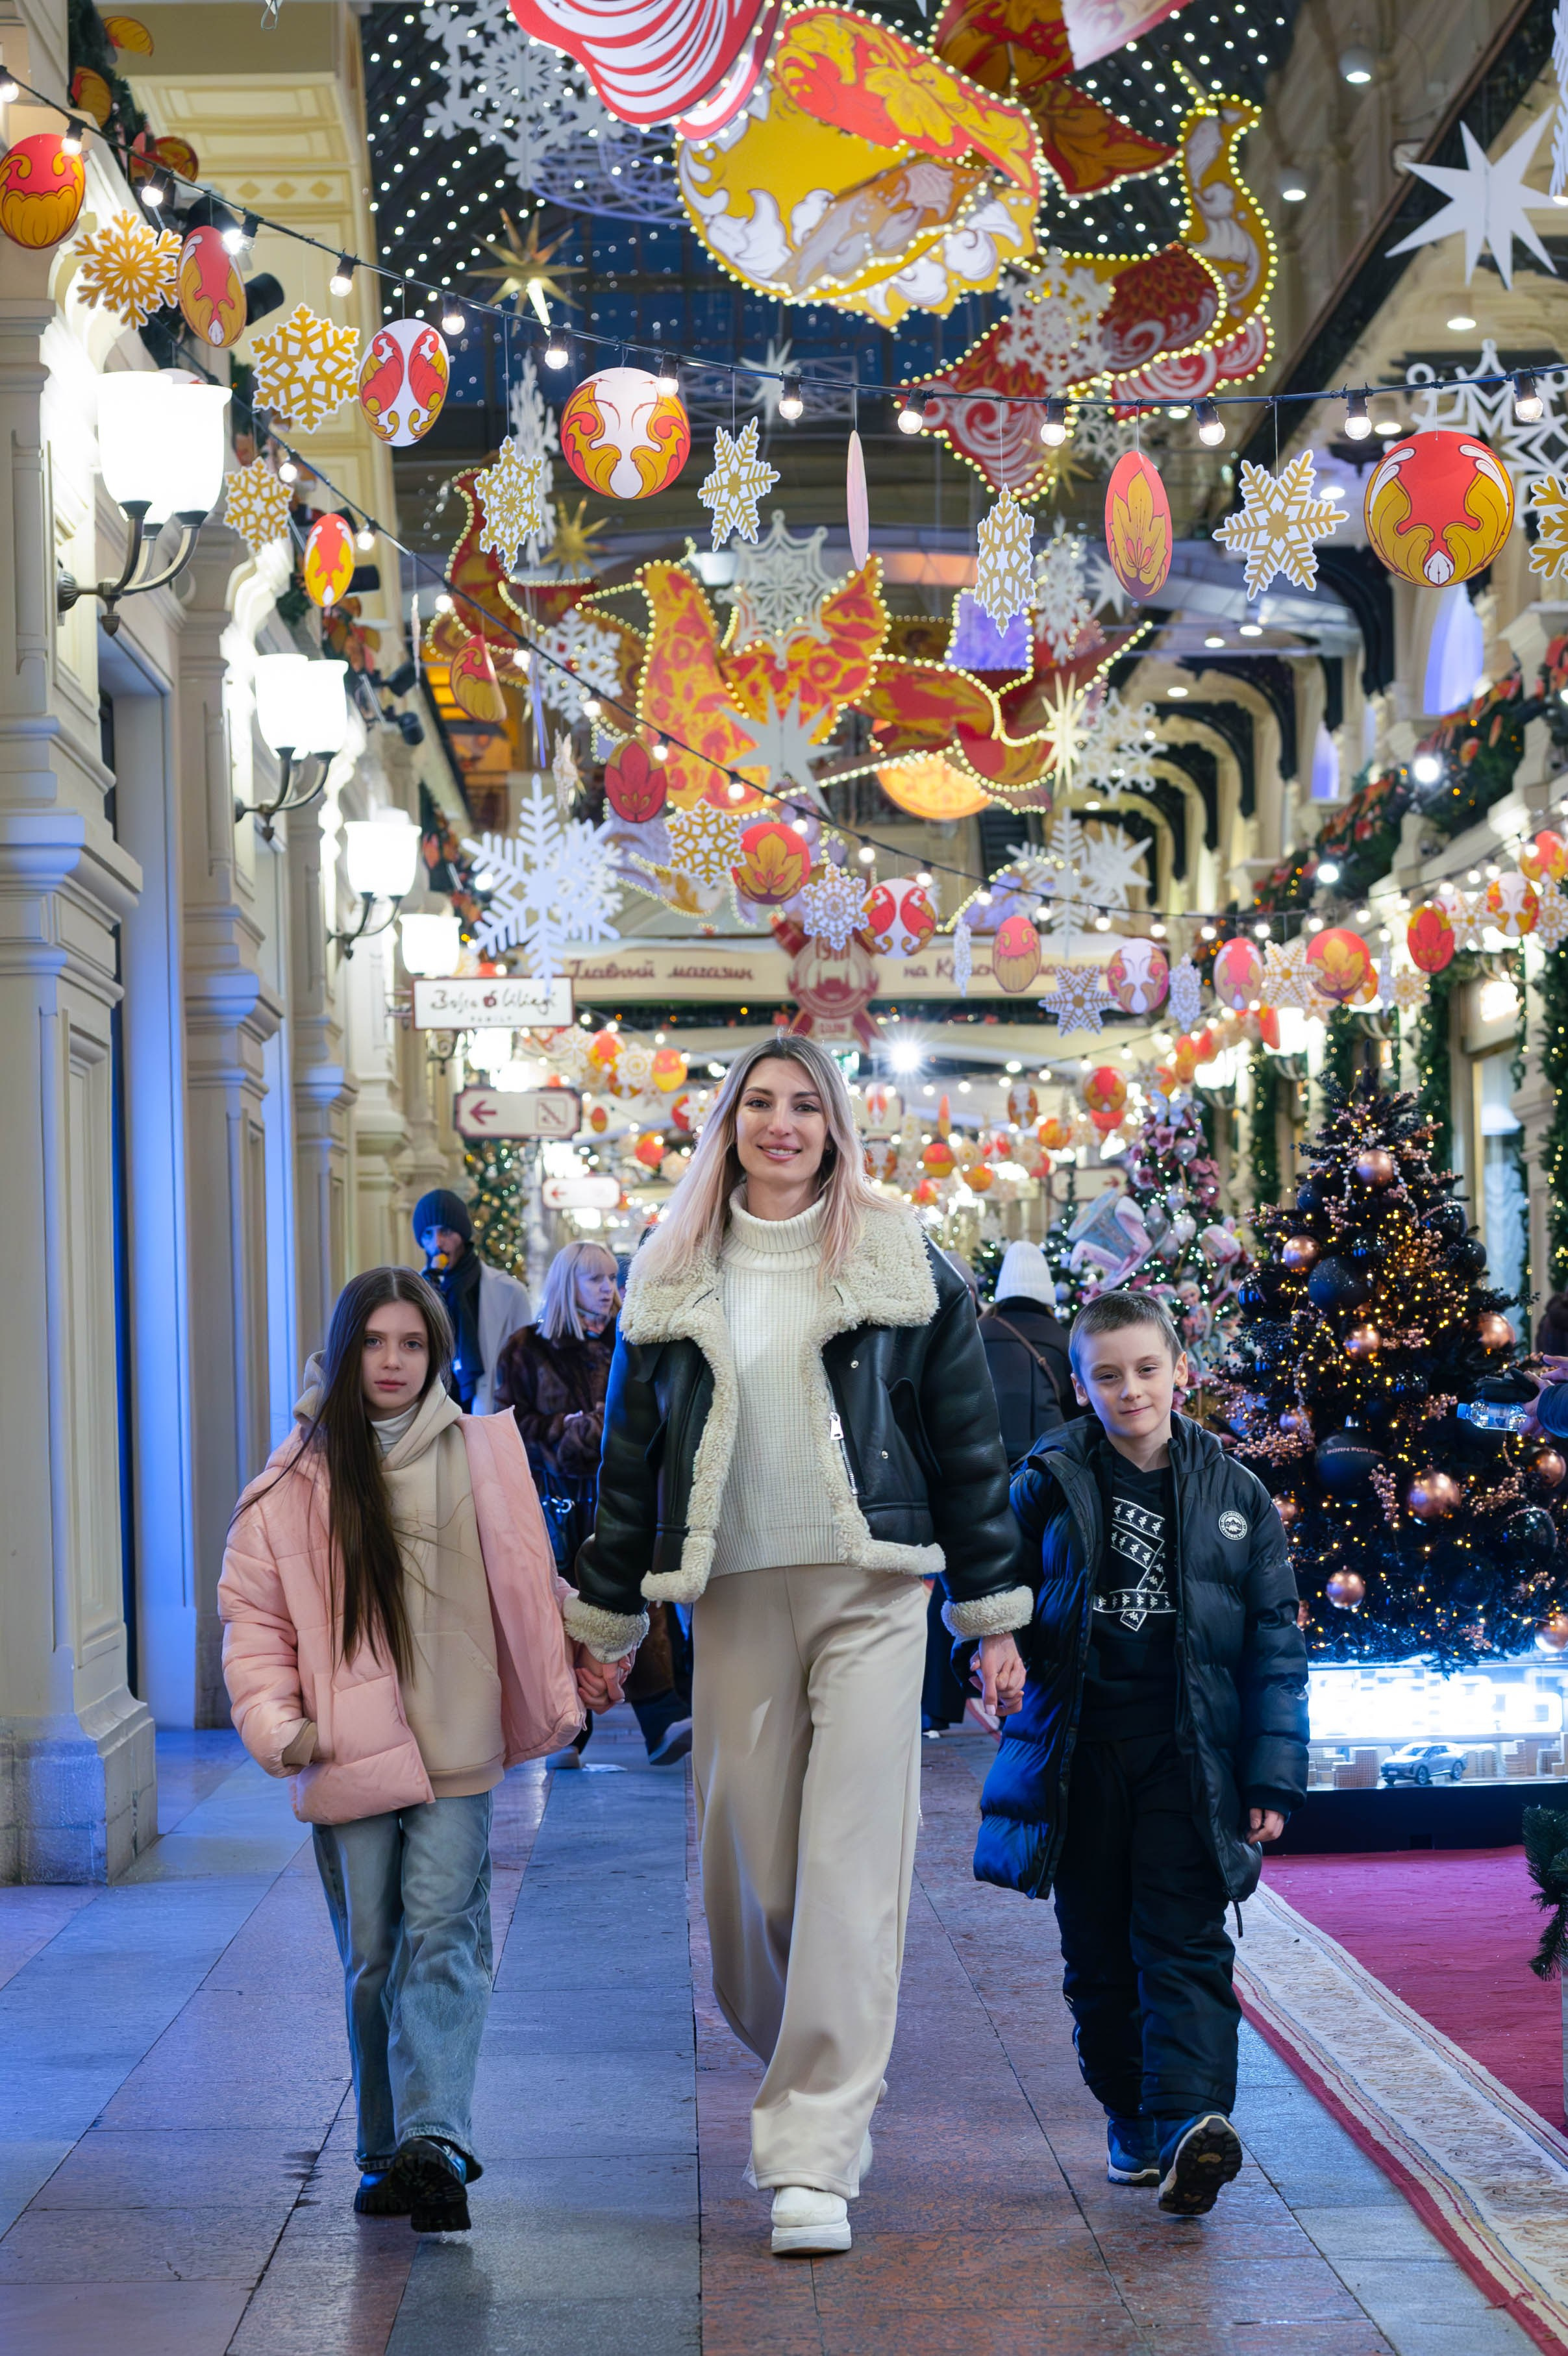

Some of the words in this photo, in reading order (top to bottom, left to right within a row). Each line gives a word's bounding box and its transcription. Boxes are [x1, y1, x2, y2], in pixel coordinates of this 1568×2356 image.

[568, 959, 655, 979] Главный
[667, 965, 754, 980] магазин
[903, 965, 928, 978] на
